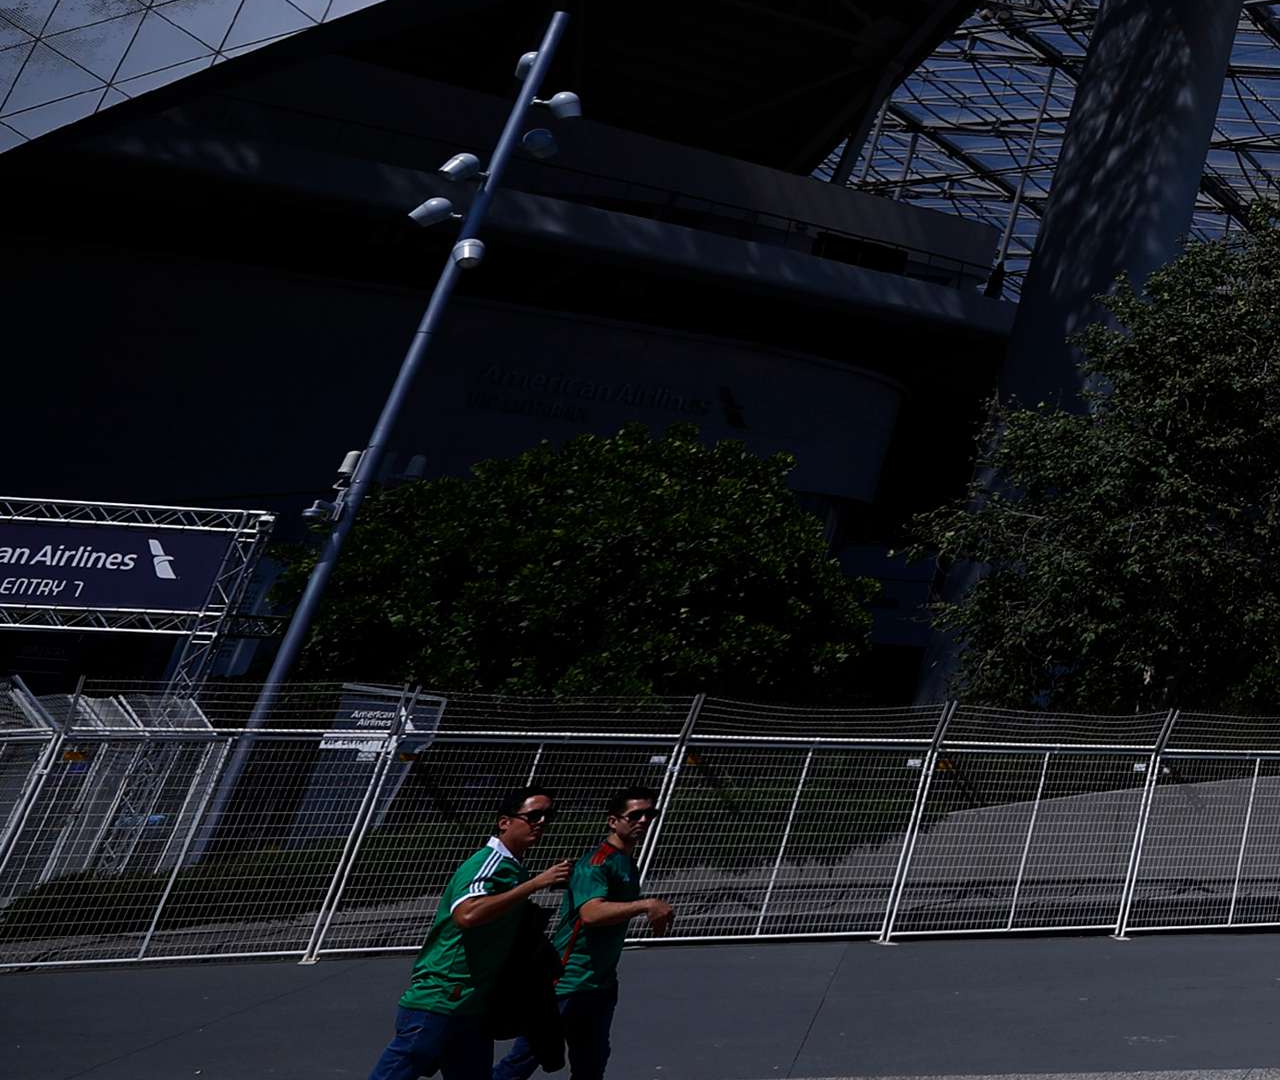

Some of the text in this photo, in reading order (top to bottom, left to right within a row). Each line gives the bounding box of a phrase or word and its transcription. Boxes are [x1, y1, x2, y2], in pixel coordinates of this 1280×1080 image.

[29, 545, 138, 570] Airlines
[0, 577, 84, 598] ENTRY 7
